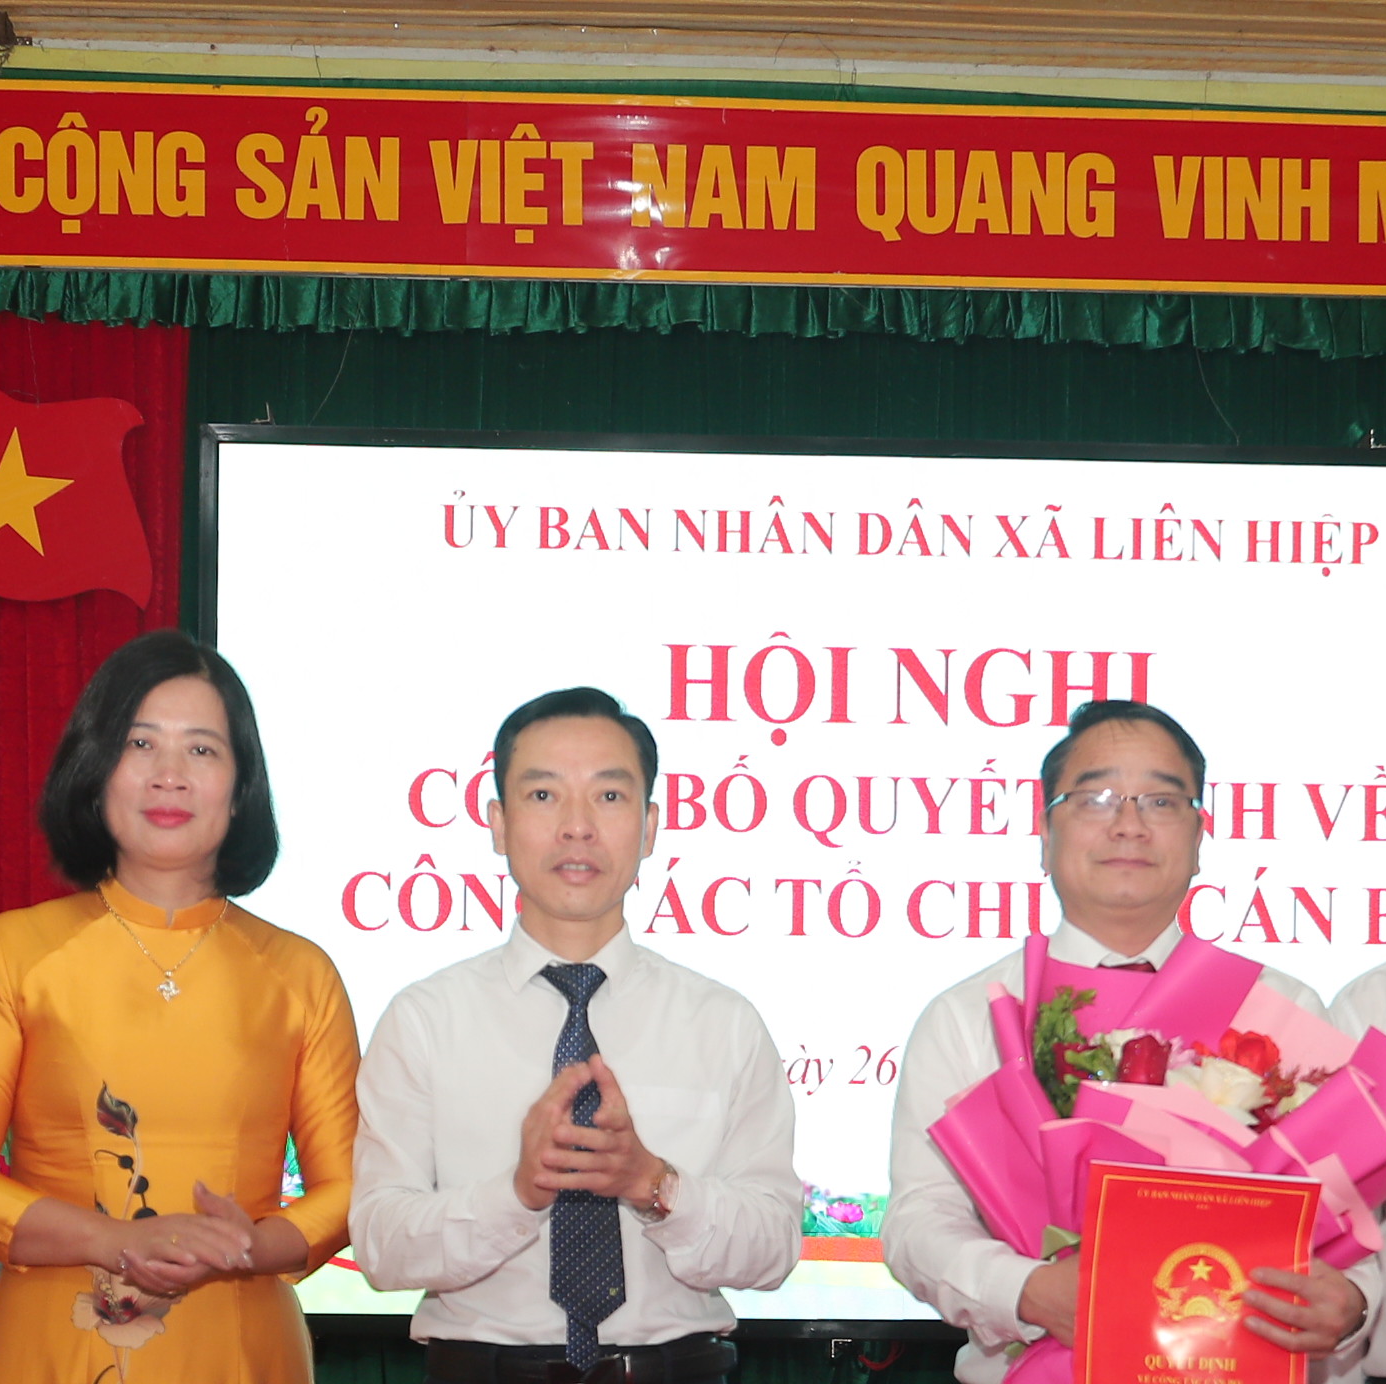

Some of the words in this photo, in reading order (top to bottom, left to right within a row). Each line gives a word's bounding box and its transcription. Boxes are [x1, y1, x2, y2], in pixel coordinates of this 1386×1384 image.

[234, 105, 401, 222] SẢN
[429, 123, 595, 244] VIỆT
[631, 143, 817, 231] NAM
[856, 145, 1116, 242] QUANG
[1153, 154, 1330, 244] VINH
[443, 490, 521, 550] ỦY
[539, 507, 653, 553] BAN
[674, 495, 836, 555] NHÂN
[857, 497, 975, 558] DÂN
[995, 504, 1072, 561] XÃ
[1093, 502, 1225, 563] LIÊN
[1246, 514, 1382, 578] HIỆP
[663, 631, 856, 746] HỘI
[659, 754, 769, 833] BỐ
[341, 853, 522, 933] CÔN
[635, 857, 753, 937] ÁC
[775, 860, 884, 939] TỔ
[1177, 866, 1339, 945] CÁN
[782, 1044, 834, 1096] ày
[848, 1045, 901, 1086] 26
